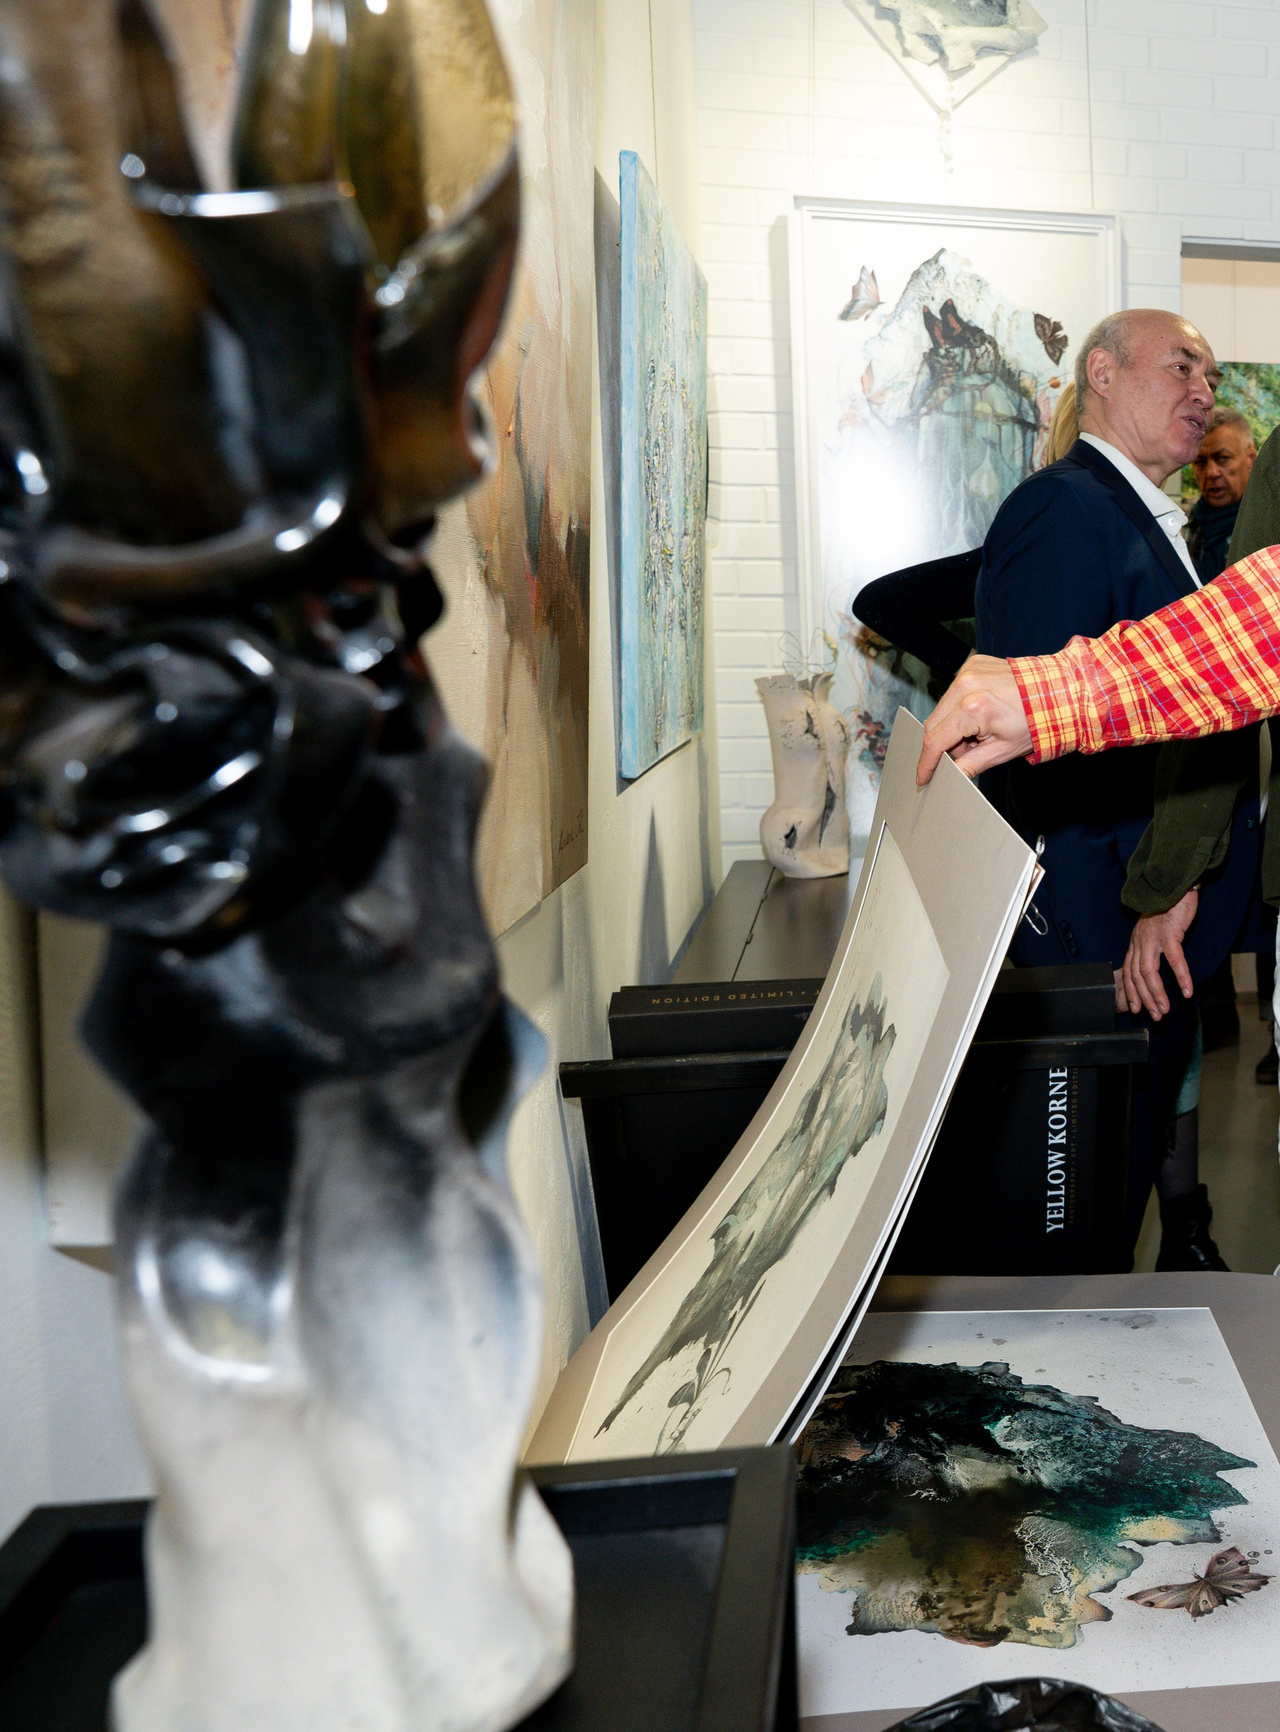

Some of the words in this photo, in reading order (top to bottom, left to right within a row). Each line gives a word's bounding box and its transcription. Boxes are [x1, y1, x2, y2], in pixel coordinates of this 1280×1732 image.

[652, 994, 720, 1005] EDITION
[727, 990, 794, 1000] LIMITED
[1046, 1149, 1066, 1234] YELLOW
